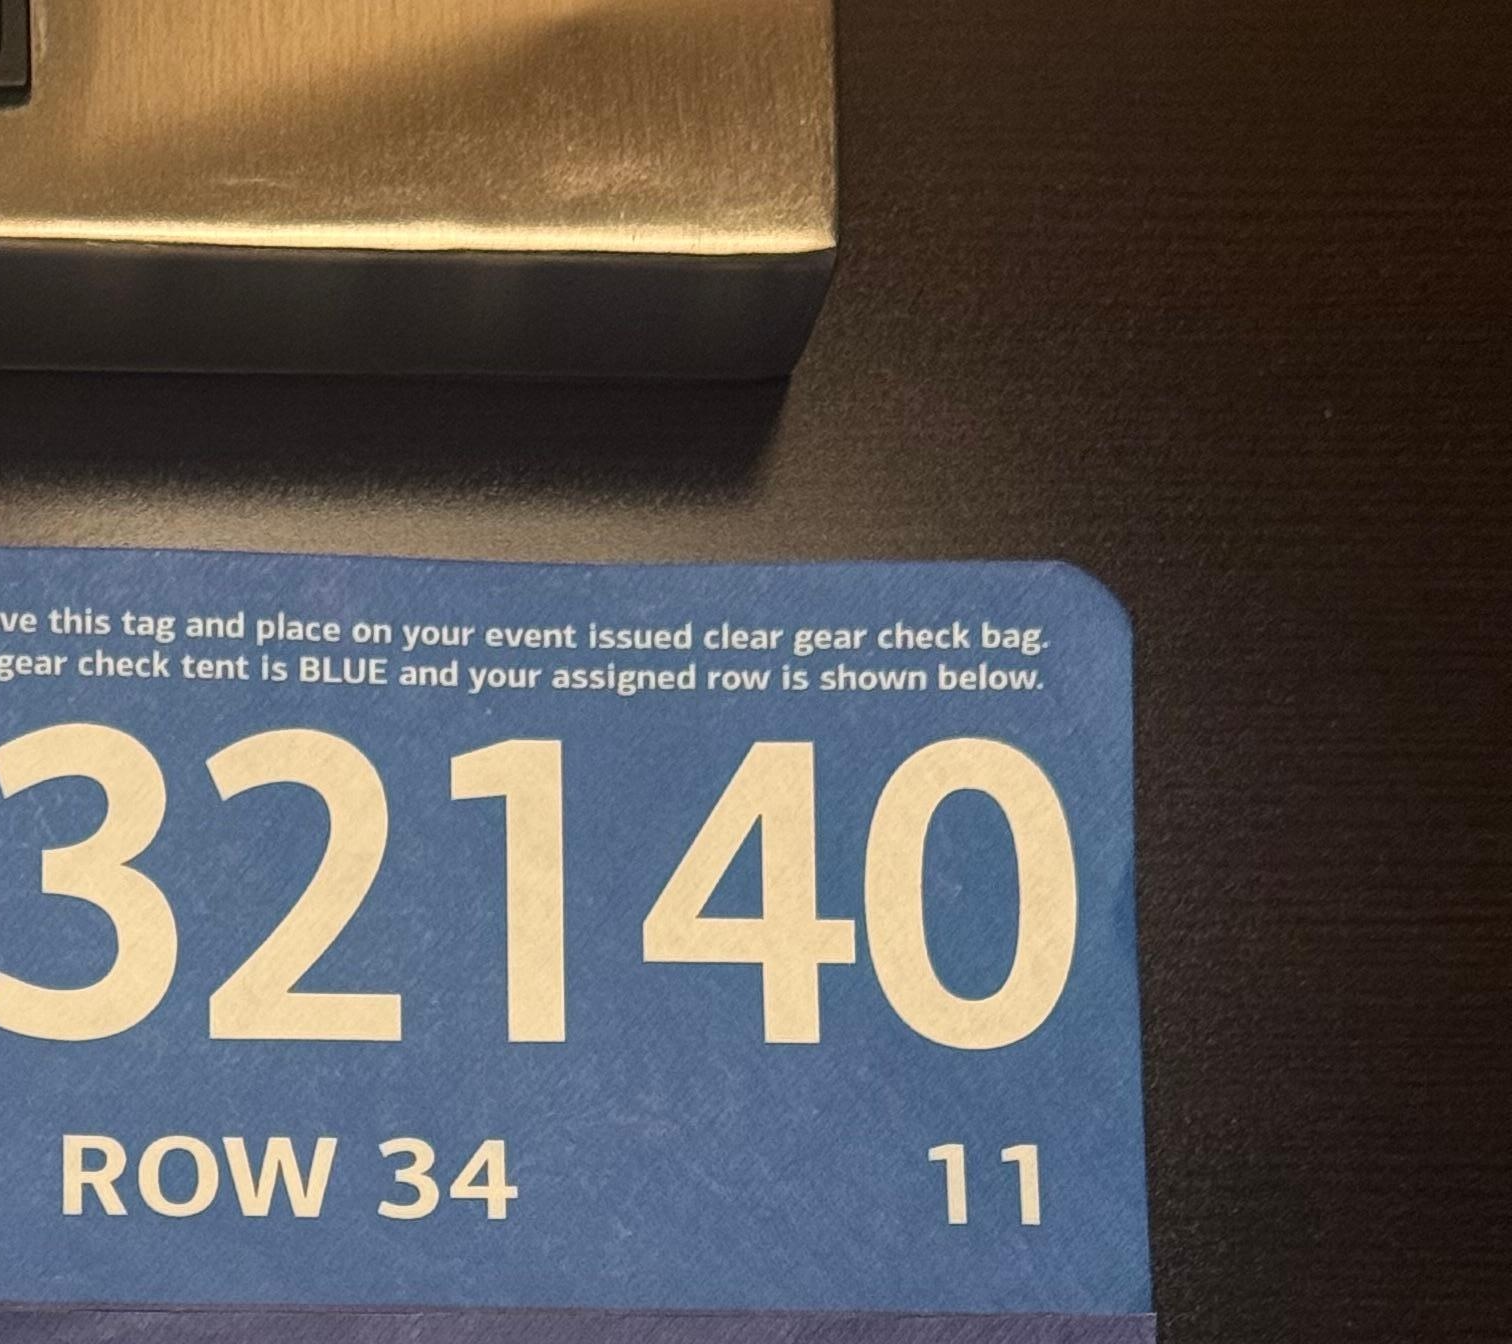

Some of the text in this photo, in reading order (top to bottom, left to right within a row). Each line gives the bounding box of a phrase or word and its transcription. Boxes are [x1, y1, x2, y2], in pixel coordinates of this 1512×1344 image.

[48, 606, 111, 635] this
[121, 610, 176, 644] tag
[185, 611, 245, 639] and
[256, 611, 341, 646] place
[351, 621, 392, 644] on
[402, 624, 476, 652] your
[485, 624, 577, 649] event
[589, 621, 693, 650] issued
[703, 622, 784, 650] clear
[793, 628, 868, 657] gear
[877, 620, 971, 650] check
[981, 621, 1049, 656] bag.
[78, 648, 170, 678] check
[181, 654, 250, 680] tent
[261, 653, 288, 682] is
[299, 655, 388, 685] BLUE
[398, 659, 459, 687] and
[468, 667, 542, 694] your
[551, 662, 696, 697] assigned
[707, 669, 771, 691] row
[782, 663, 810, 691] is
[819, 663, 928, 691] shown
[938, 662, 1044, 691] below.
[62, 1134, 519, 1220] ROW 34
[928, 1143, 1041, 1226] 11
